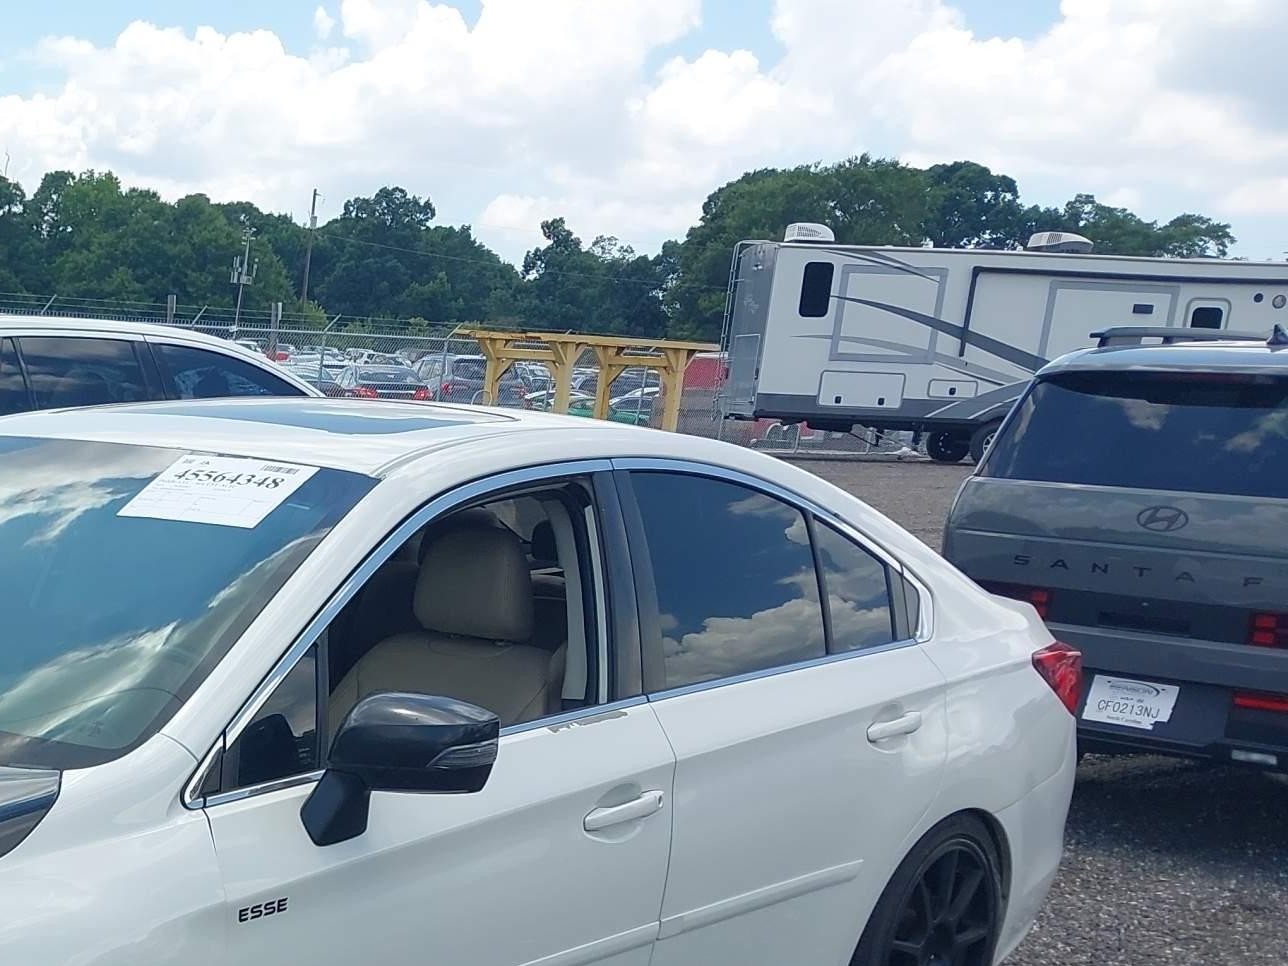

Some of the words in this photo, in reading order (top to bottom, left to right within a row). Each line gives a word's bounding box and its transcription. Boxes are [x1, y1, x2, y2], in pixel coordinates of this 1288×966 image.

[174, 468, 286, 489] 45564348
[1013, 555, 1196, 583] SANTA
[1097, 699, 1161, 719] CF0213NJ
[238, 897, 289, 923] ESSE
